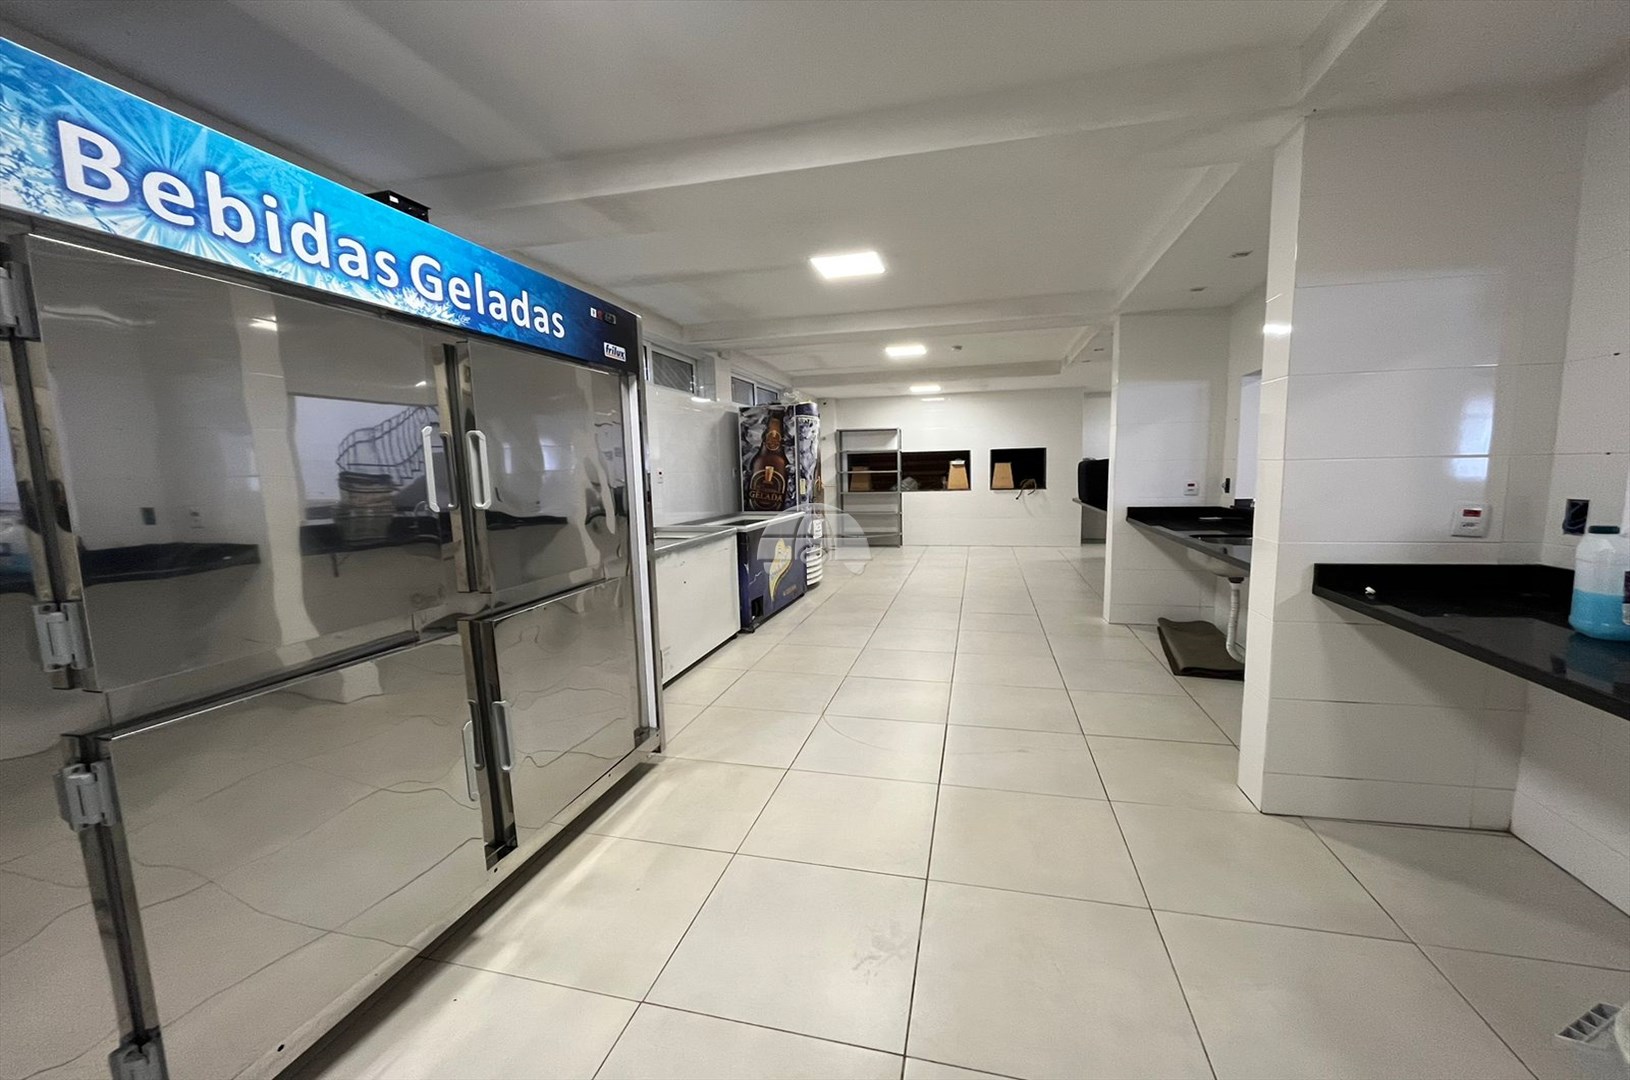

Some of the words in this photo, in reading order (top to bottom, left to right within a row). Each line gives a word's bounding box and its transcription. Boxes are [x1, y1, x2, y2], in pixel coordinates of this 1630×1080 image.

[57, 119, 400, 288] Bebidas
[410, 254, 565, 338] Geladas
[605, 344, 625, 360] frilux
[749, 490, 783, 501] GELADA
